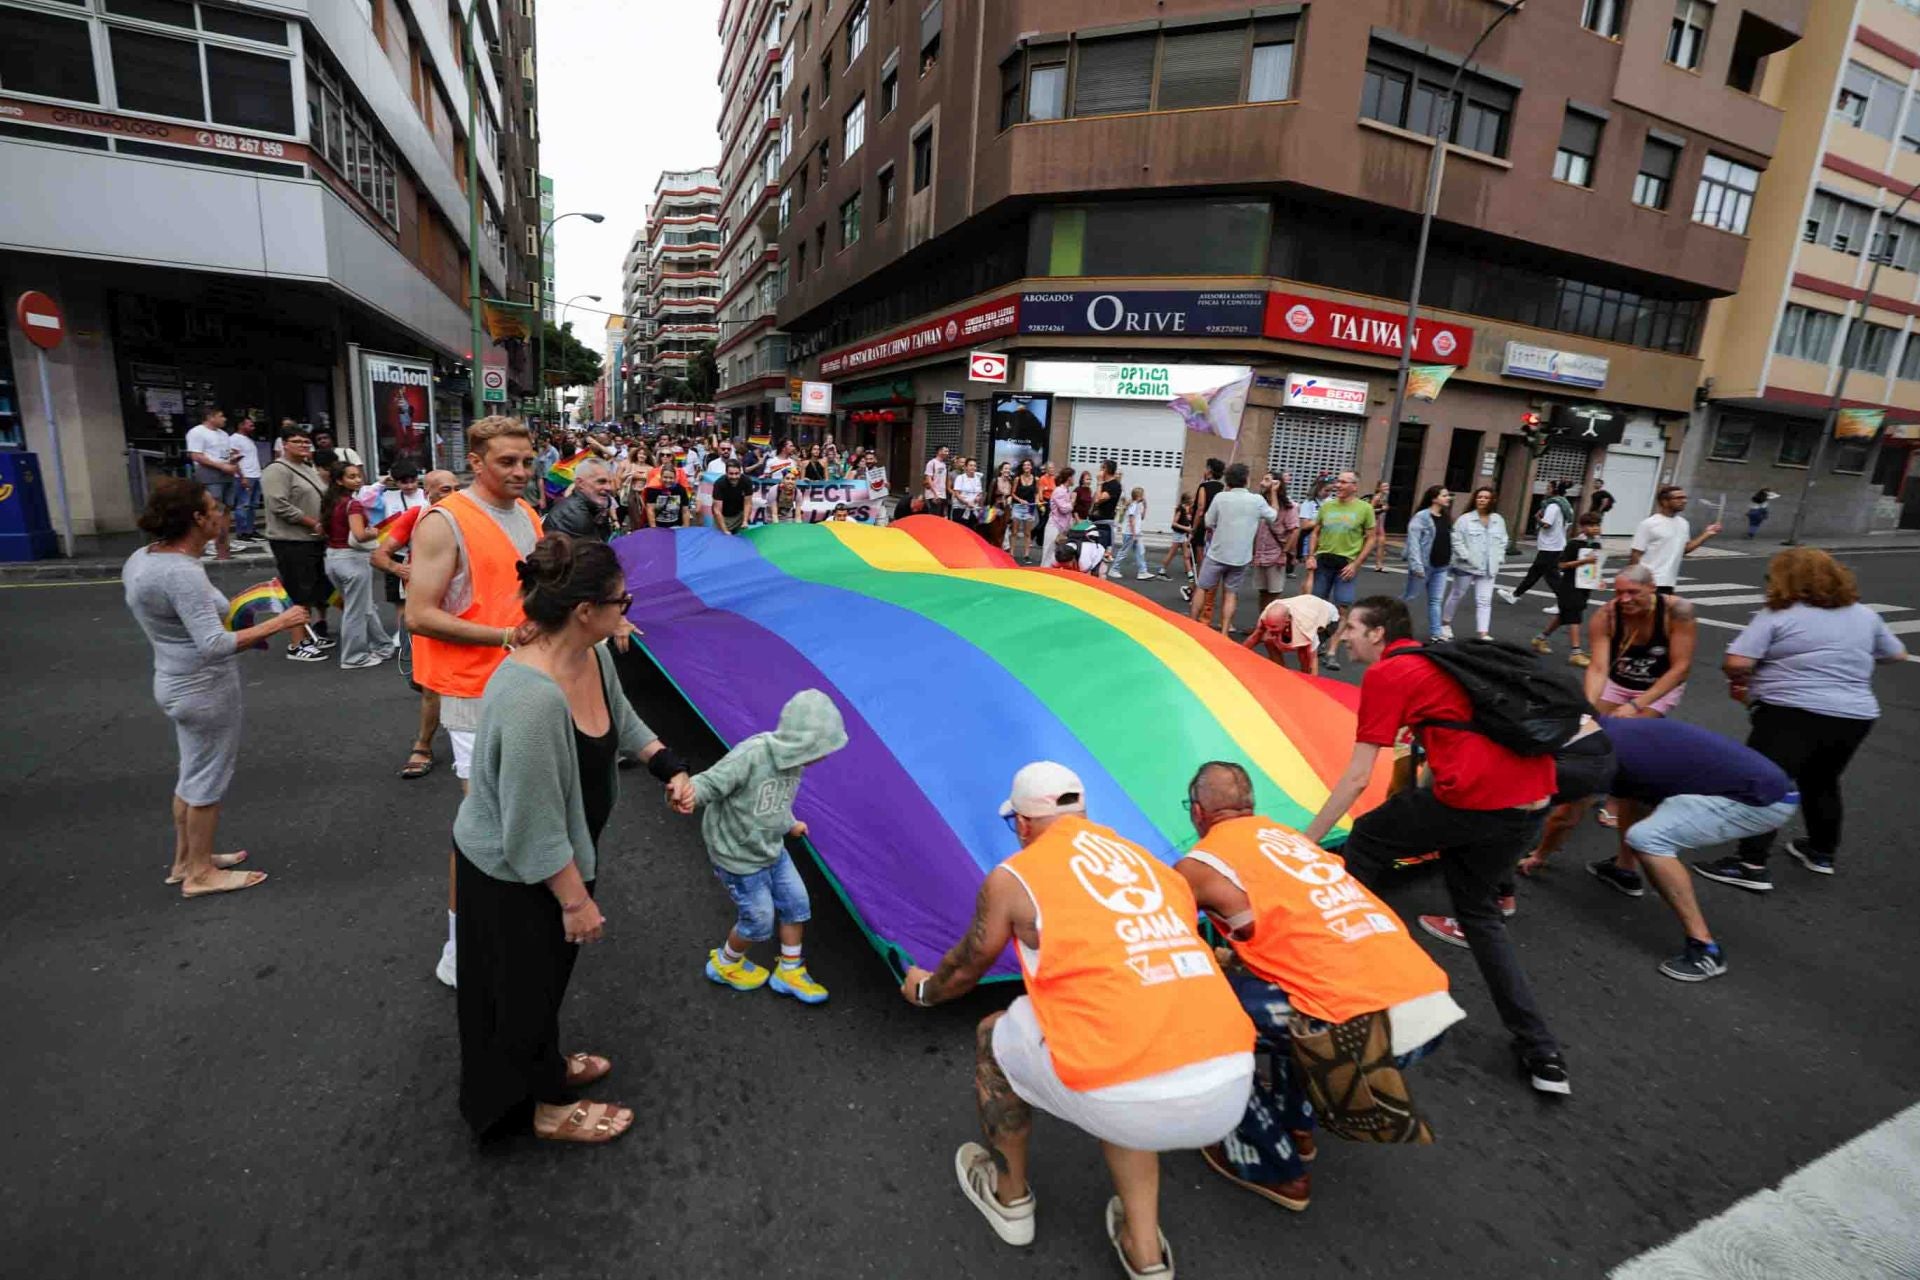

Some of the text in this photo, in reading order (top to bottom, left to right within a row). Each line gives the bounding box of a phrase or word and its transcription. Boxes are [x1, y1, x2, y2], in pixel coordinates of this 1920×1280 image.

[52, 109, 169, 138] OFTALMOLOGO
[214, 133, 285, 157] 928 267 959
[1023, 294, 1074, 302] ABOGADOS
[1086, 294, 1187, 332] ORIVE
[1028, 324, 1065, 332] 928274261
[1329, 312, 1422, 351] TAIWAN
[848, 343, 888, 367] RESTAURANTE
[888, 336, 911, 357] CHINO
[912, 326, 943, 350] TAIWAN
[372, 362, 430, 386] Mahou
[751, 481, 856, 503] PRTECT
[1115, 904, 1192, 943] GAMA
